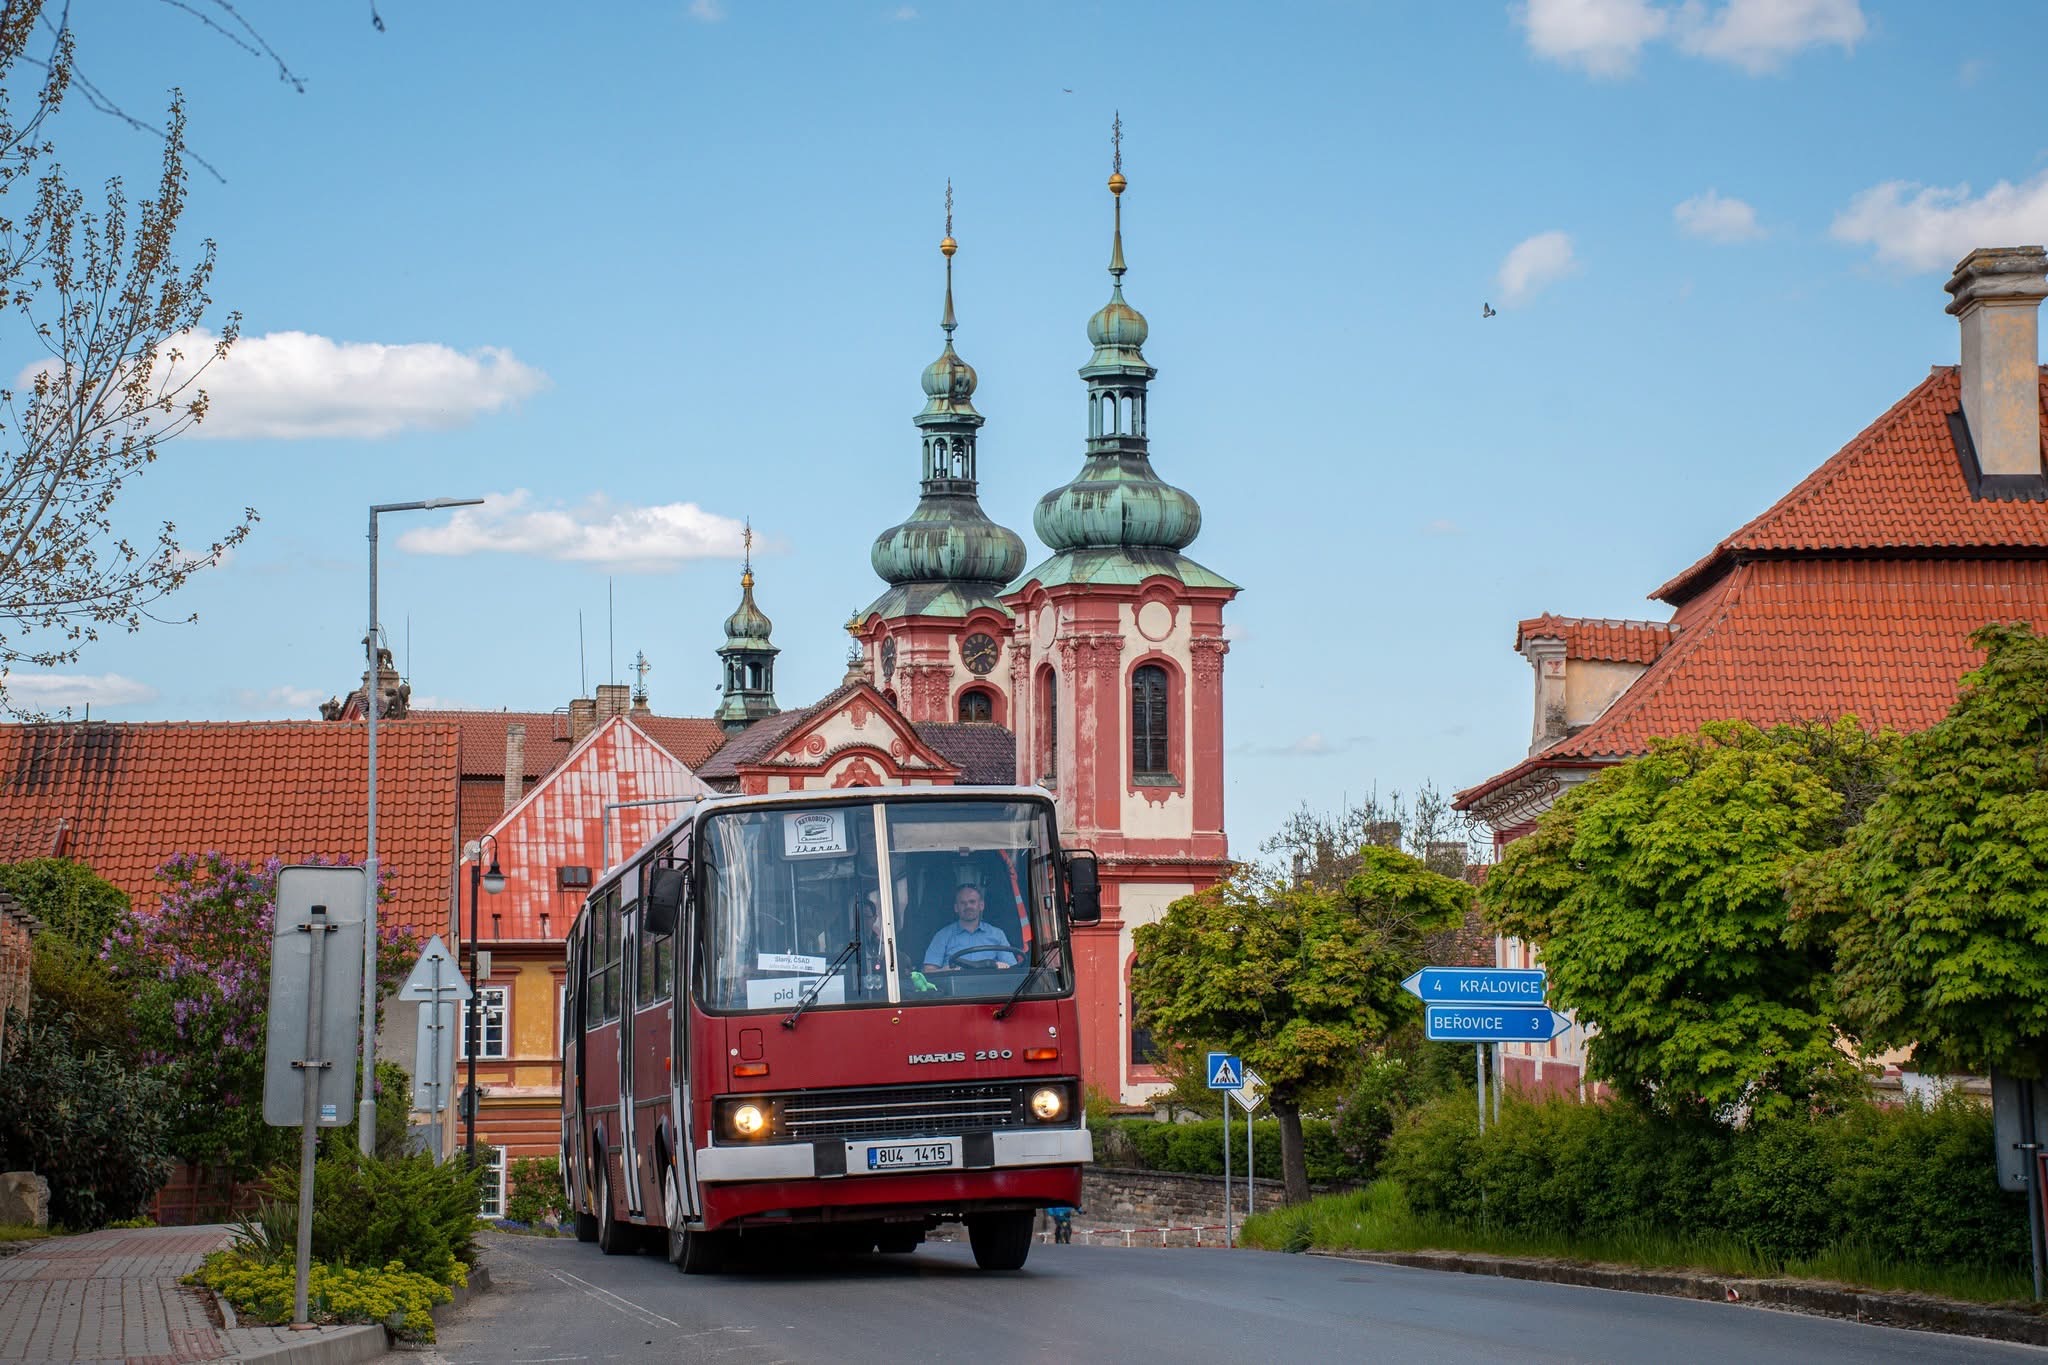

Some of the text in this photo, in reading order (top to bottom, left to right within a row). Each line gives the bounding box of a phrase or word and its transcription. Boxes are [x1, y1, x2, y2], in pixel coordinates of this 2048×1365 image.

[793, 955, 810, 964] ČSAD
[1433, 977, 1539, 994] 4 KRÁLOVICE
[774, 988, 794, 1003] pid
[1434, 1013, 1540, 1030] BEŘOVICE 3
[908, 1049, 1013, 1065] IKARUS 280
[880, 1149, 903, 1163] 8U4
[914, 1146, 945, 1161] 1415
